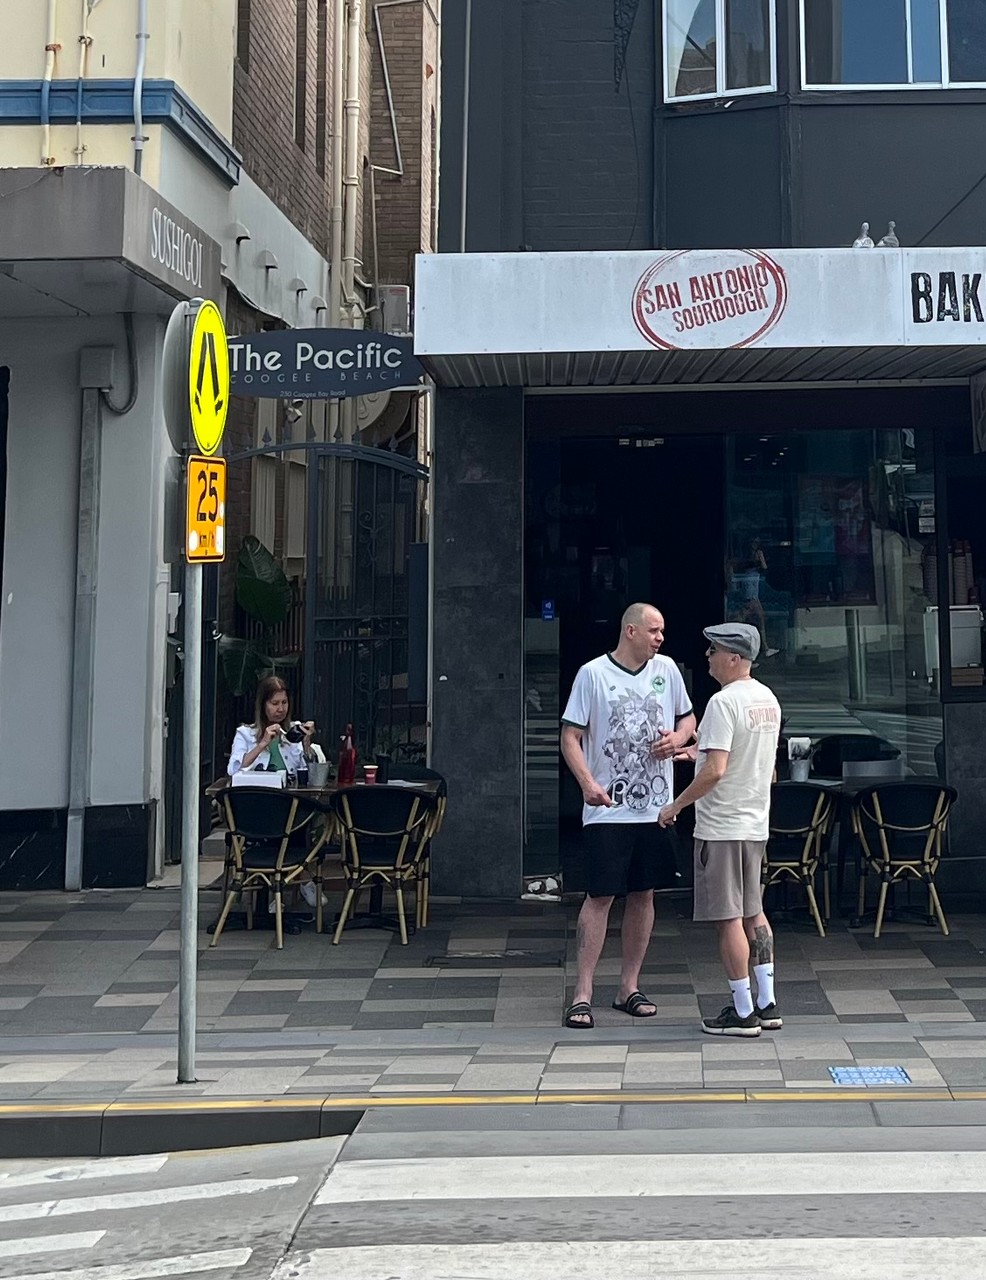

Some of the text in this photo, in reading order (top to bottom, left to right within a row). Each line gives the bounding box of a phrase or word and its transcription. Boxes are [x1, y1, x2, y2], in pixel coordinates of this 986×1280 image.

[151, 207, 203, 289] SUSHIGOI
[642, 262, 769, 315] SAN ANTONIO
[672, 288, 769, 332] SOURDOUGH
[228, 342, 402, 371] The Pacific
[230, 371, 401, 384] COOGEE BEACH
[330, 389, 346, 397] Road
[197, 470, 218, 522] 25
